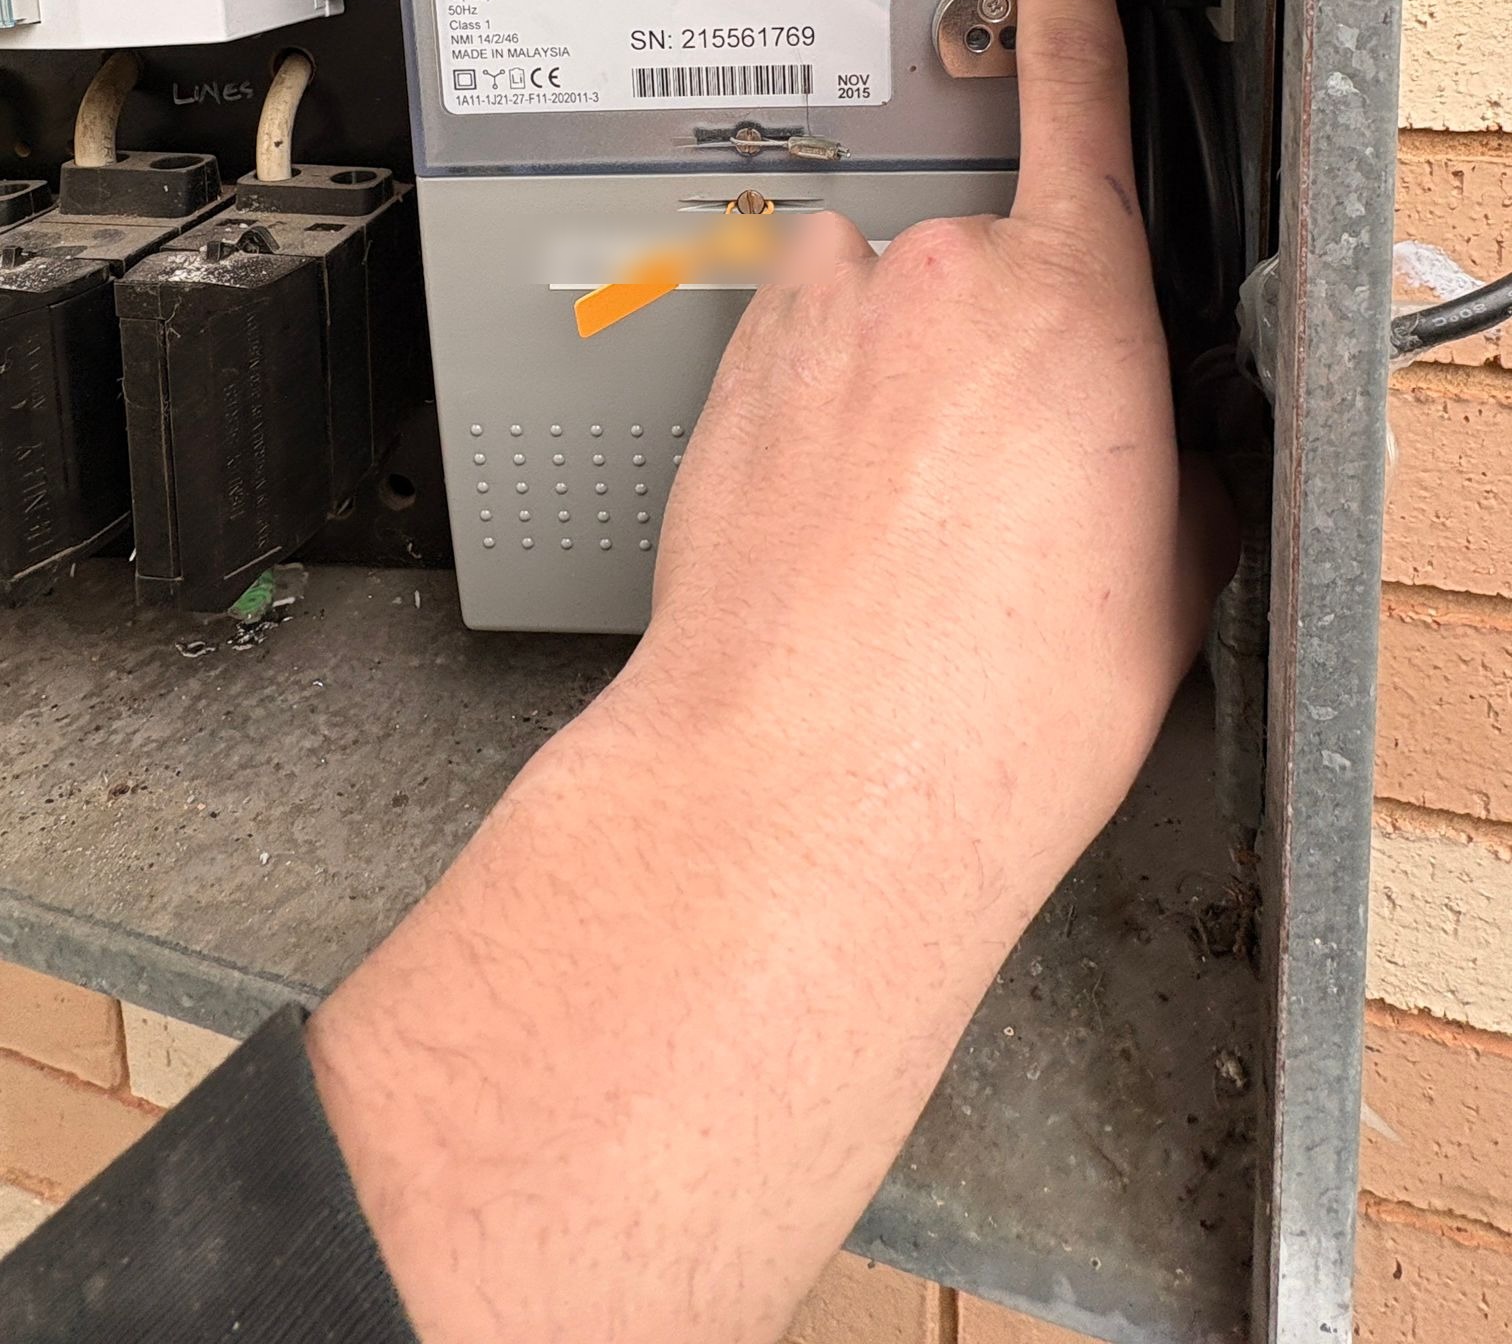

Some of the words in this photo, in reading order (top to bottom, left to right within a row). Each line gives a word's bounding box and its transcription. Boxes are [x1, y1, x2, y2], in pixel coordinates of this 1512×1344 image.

[448, 5, 478, 16] 50Hz
[450, 19, 481, 31] Class
[485, 19, 491, 30] 1
[451, 34, 474, 45] NMI
[478, 33, 519, 45] 14/2/46
[631, 29, 672, 51] SN:
[681, 26, 815, 49] 215561769
[452, 48, 488, 60] MADE
[492, 48, 504, 59] IN
[507, 47, 570, 59] MALAYSIA
[837, 74, 870, 86] NOV
[837, 88, 871, 99] 2015
